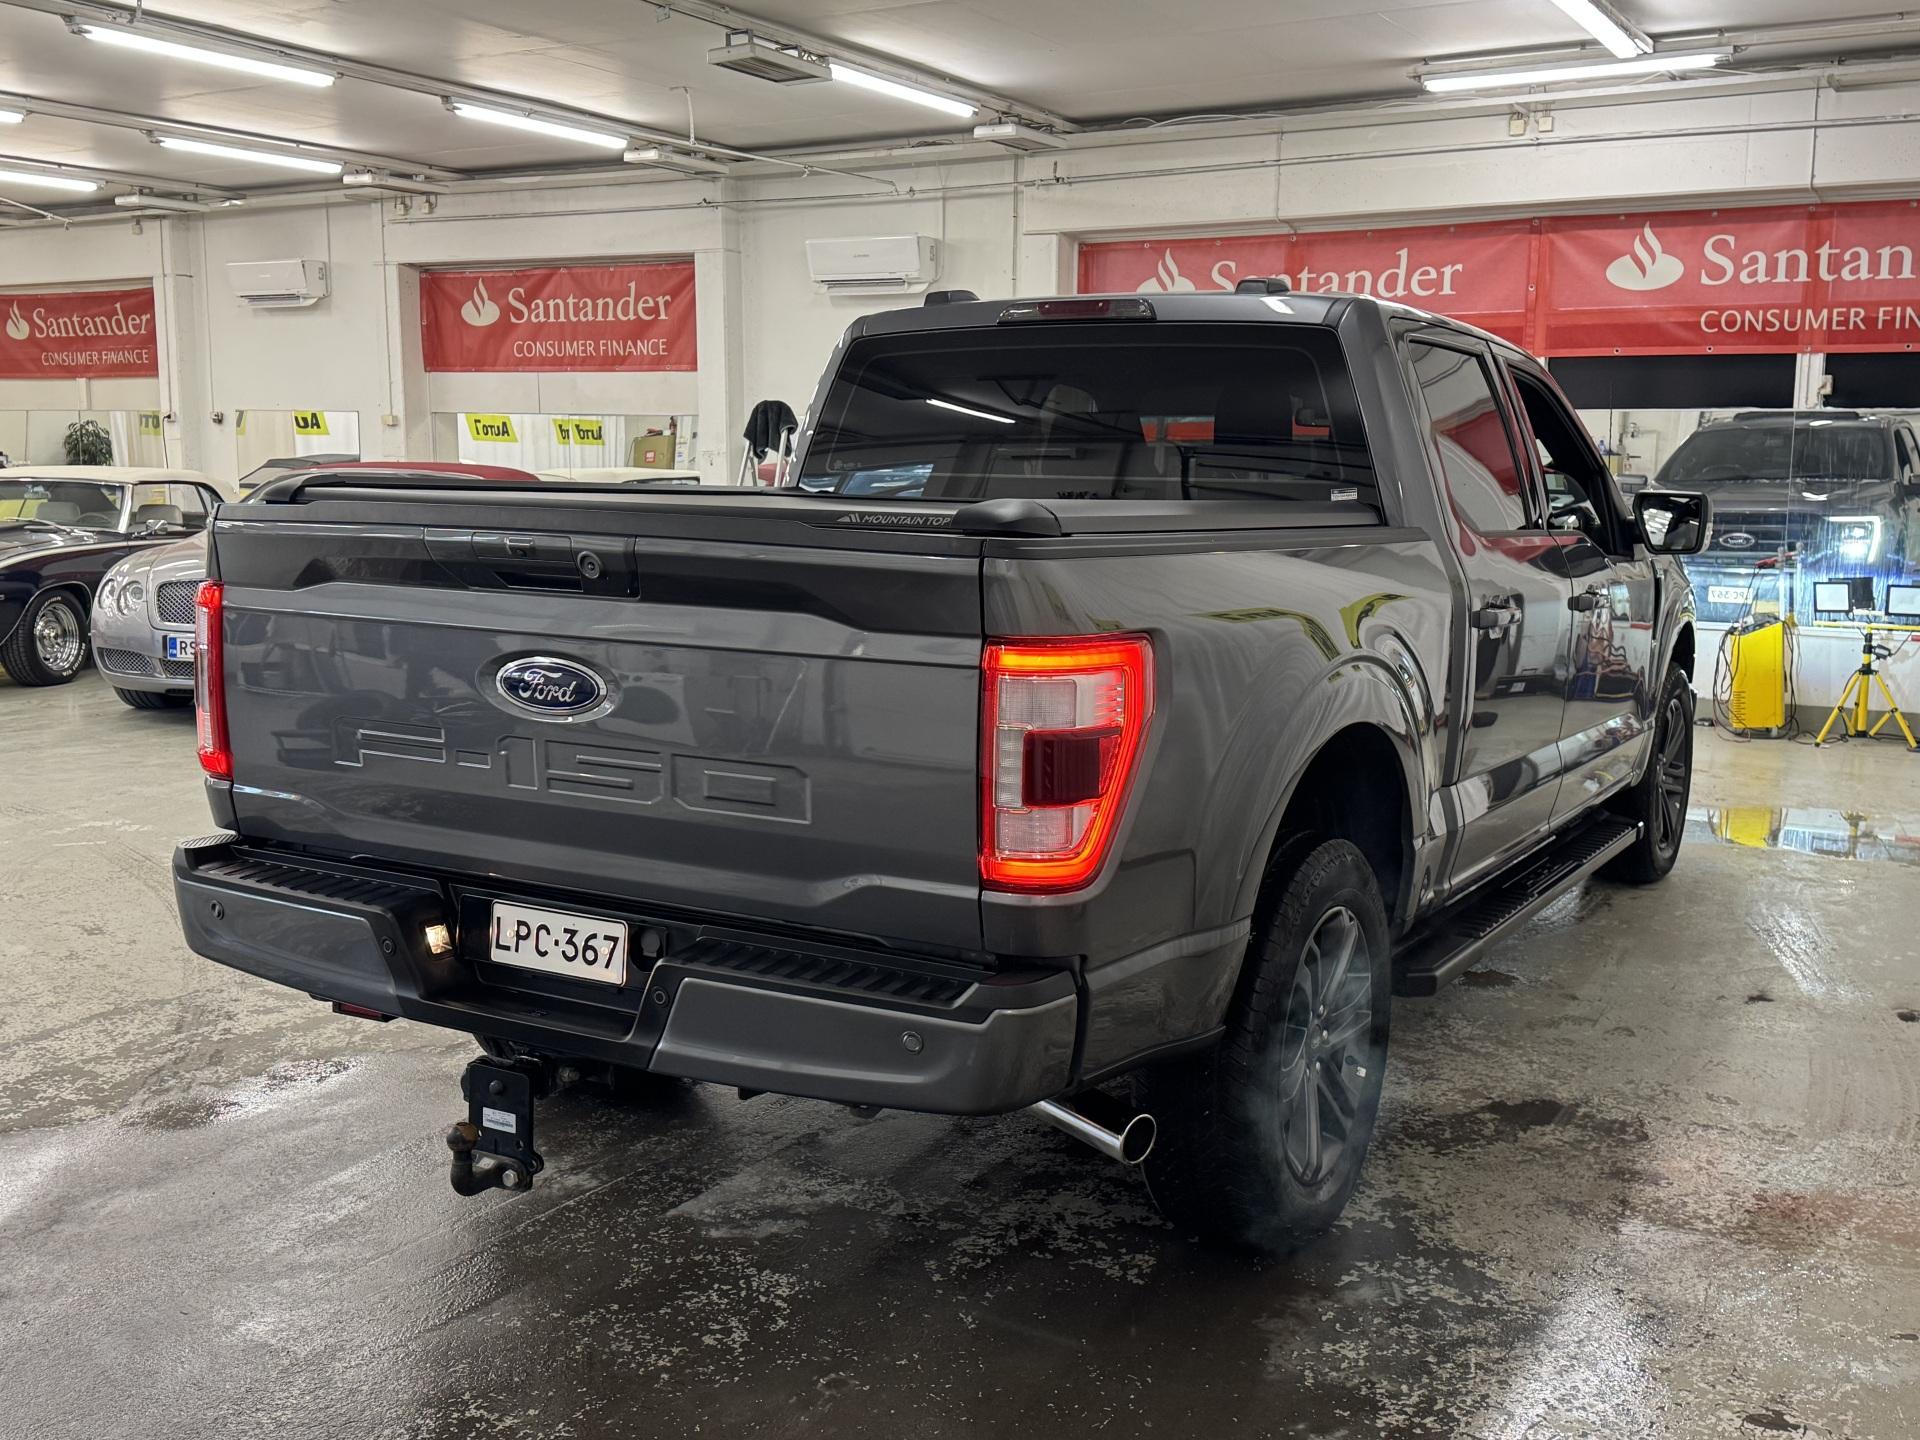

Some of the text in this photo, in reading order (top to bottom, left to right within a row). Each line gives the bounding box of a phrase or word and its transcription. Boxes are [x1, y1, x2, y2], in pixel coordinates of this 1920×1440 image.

[1211, 248, 1463, 298] Stander
[1700, 234, 1917, 286] Santan
[33, 301, 151, 338] Santander
[508, 280, 672, 324] Santander
[1700, 307, 1866, 334] CONSUMER
[41, 349, 150, 366] CONSUMER FINANCE
[513, 338, 669, 358] CONSUMER FINANCE
[862, 514, 952, 526] MOUNTAIN TOP
[518, 668, 577, 703] Ford
[331, 716, 812, 825] F-150
